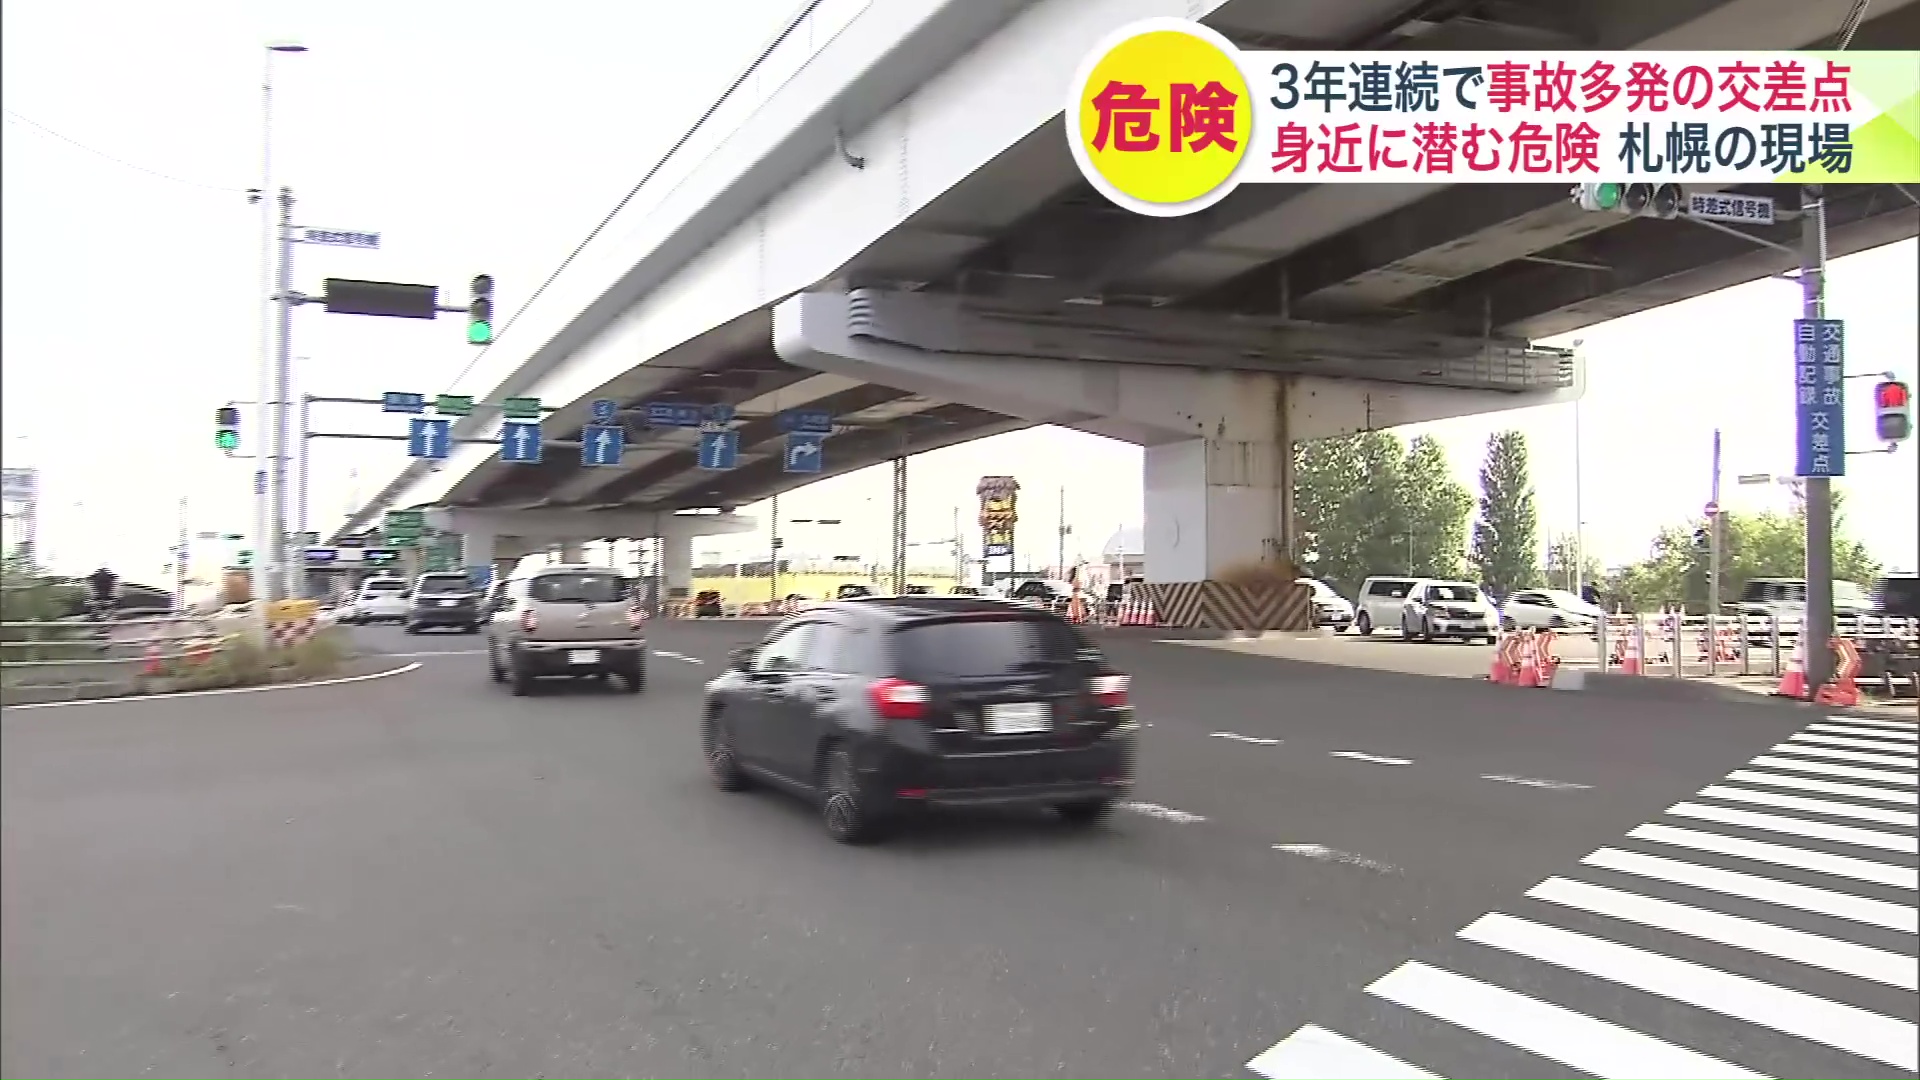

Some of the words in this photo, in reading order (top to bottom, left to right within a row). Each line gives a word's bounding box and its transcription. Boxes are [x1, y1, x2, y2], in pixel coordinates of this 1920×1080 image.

[1692, 197, 1771, 219] 時差式信号機
[1799, 323, 1817, 406] 自動記録
[1823, 323, 1842, 406] 交通事故
[1811, 411, 1831, 473] 交差点
